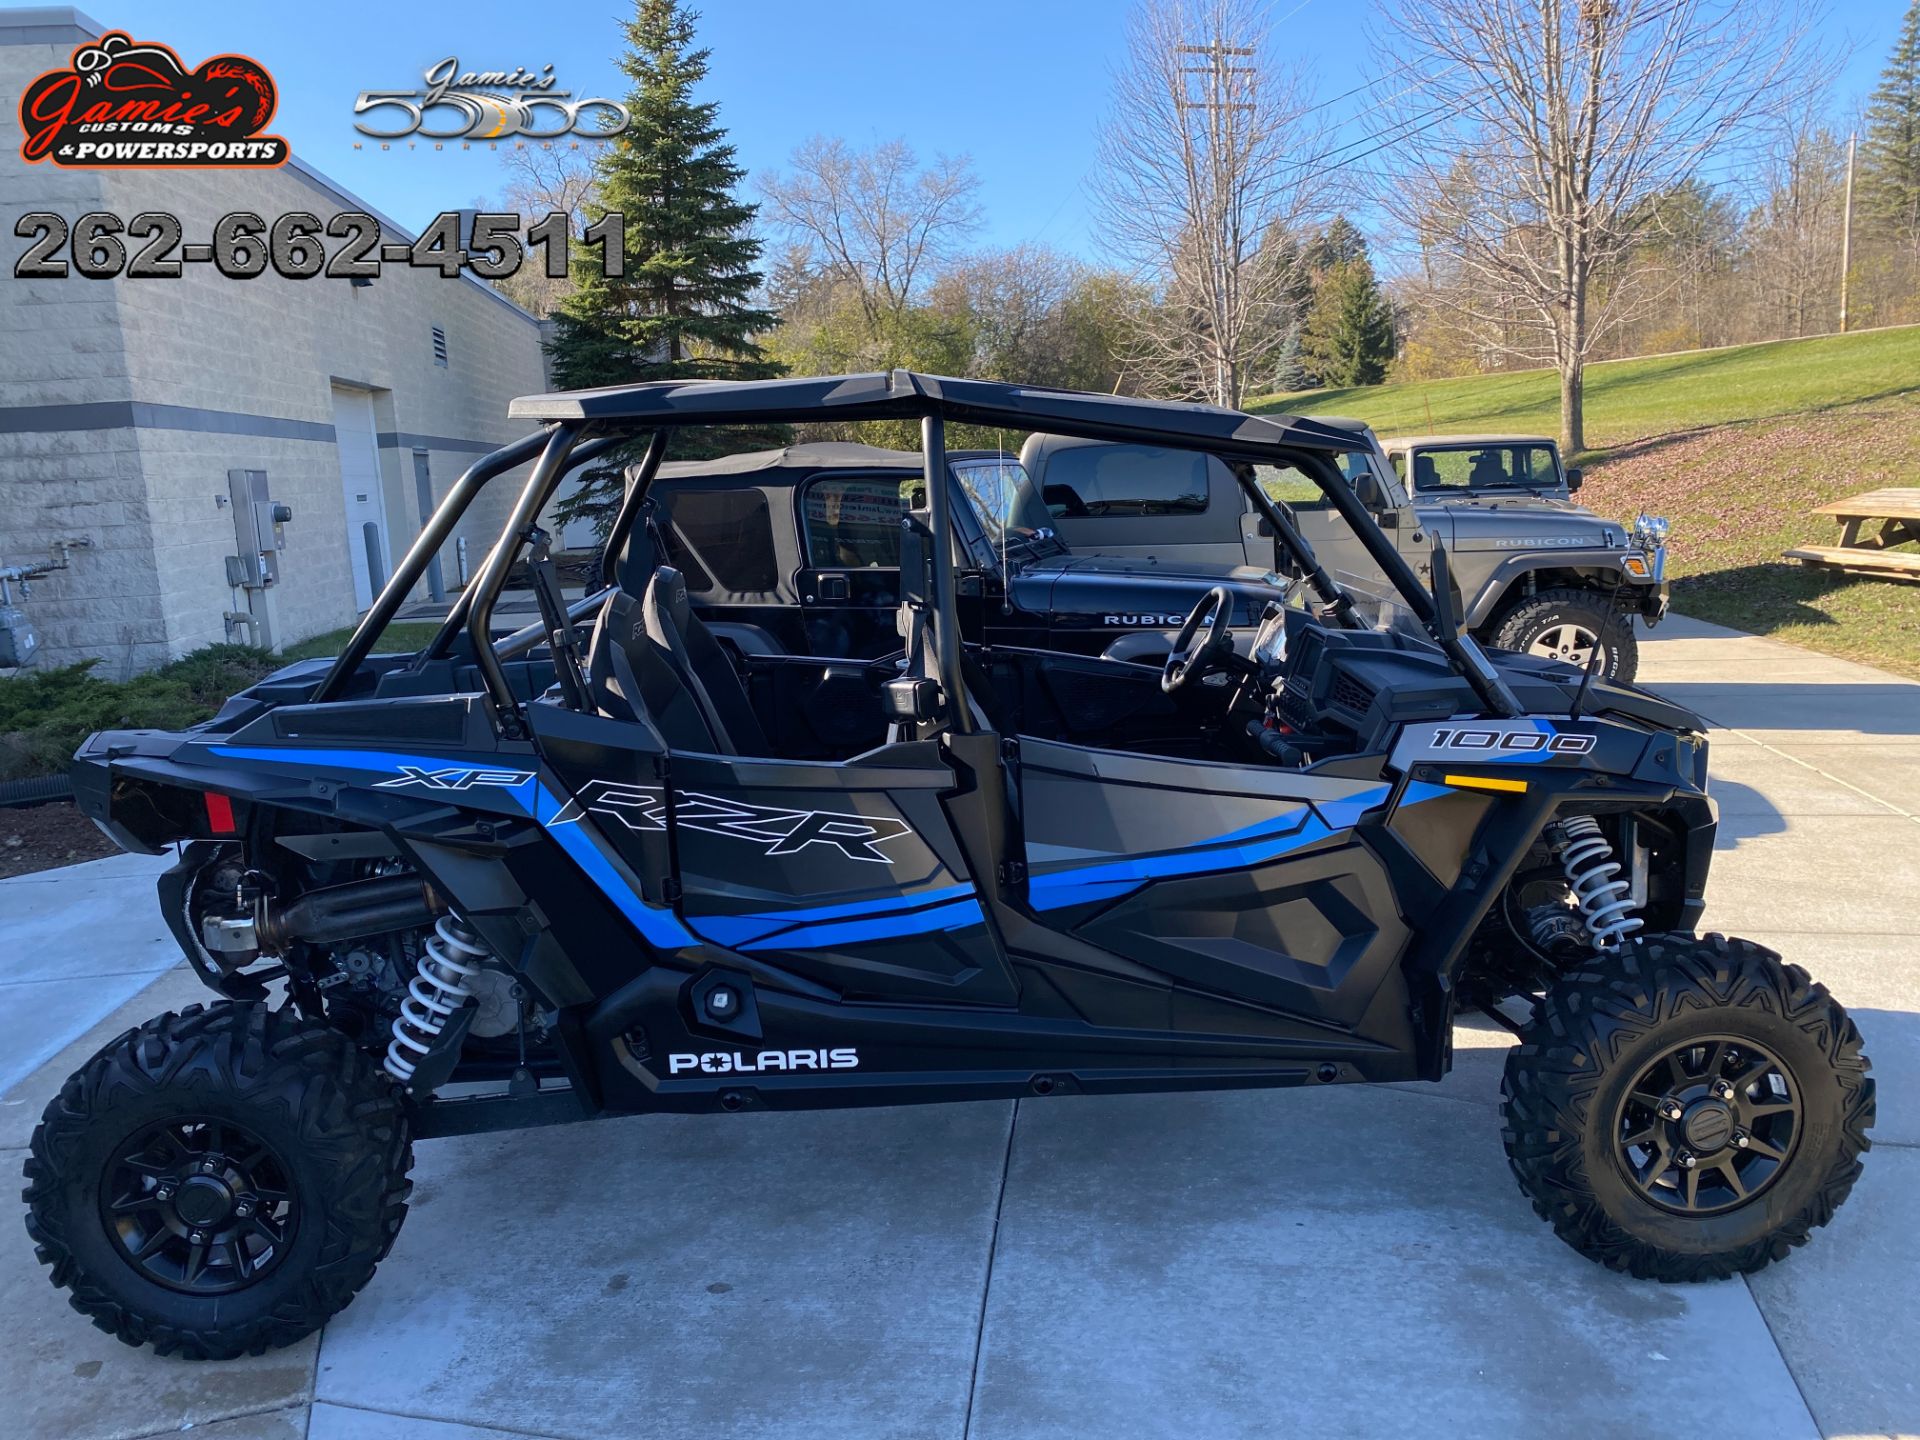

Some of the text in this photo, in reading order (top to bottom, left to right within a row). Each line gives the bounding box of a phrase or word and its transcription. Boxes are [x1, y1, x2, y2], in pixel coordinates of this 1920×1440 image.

[1496, 537, 1584, 547] RUBICON
[1104, 615, 1216, 625] RUBICN
[1609, 646, 1619, 679] BFGo
[1429, 728, 1597, 755] 1000
[371, 765, 537, 791] XP
[547, 779, 912, 864] RZR
[669, 1048, 859, 1074] POLARIS
